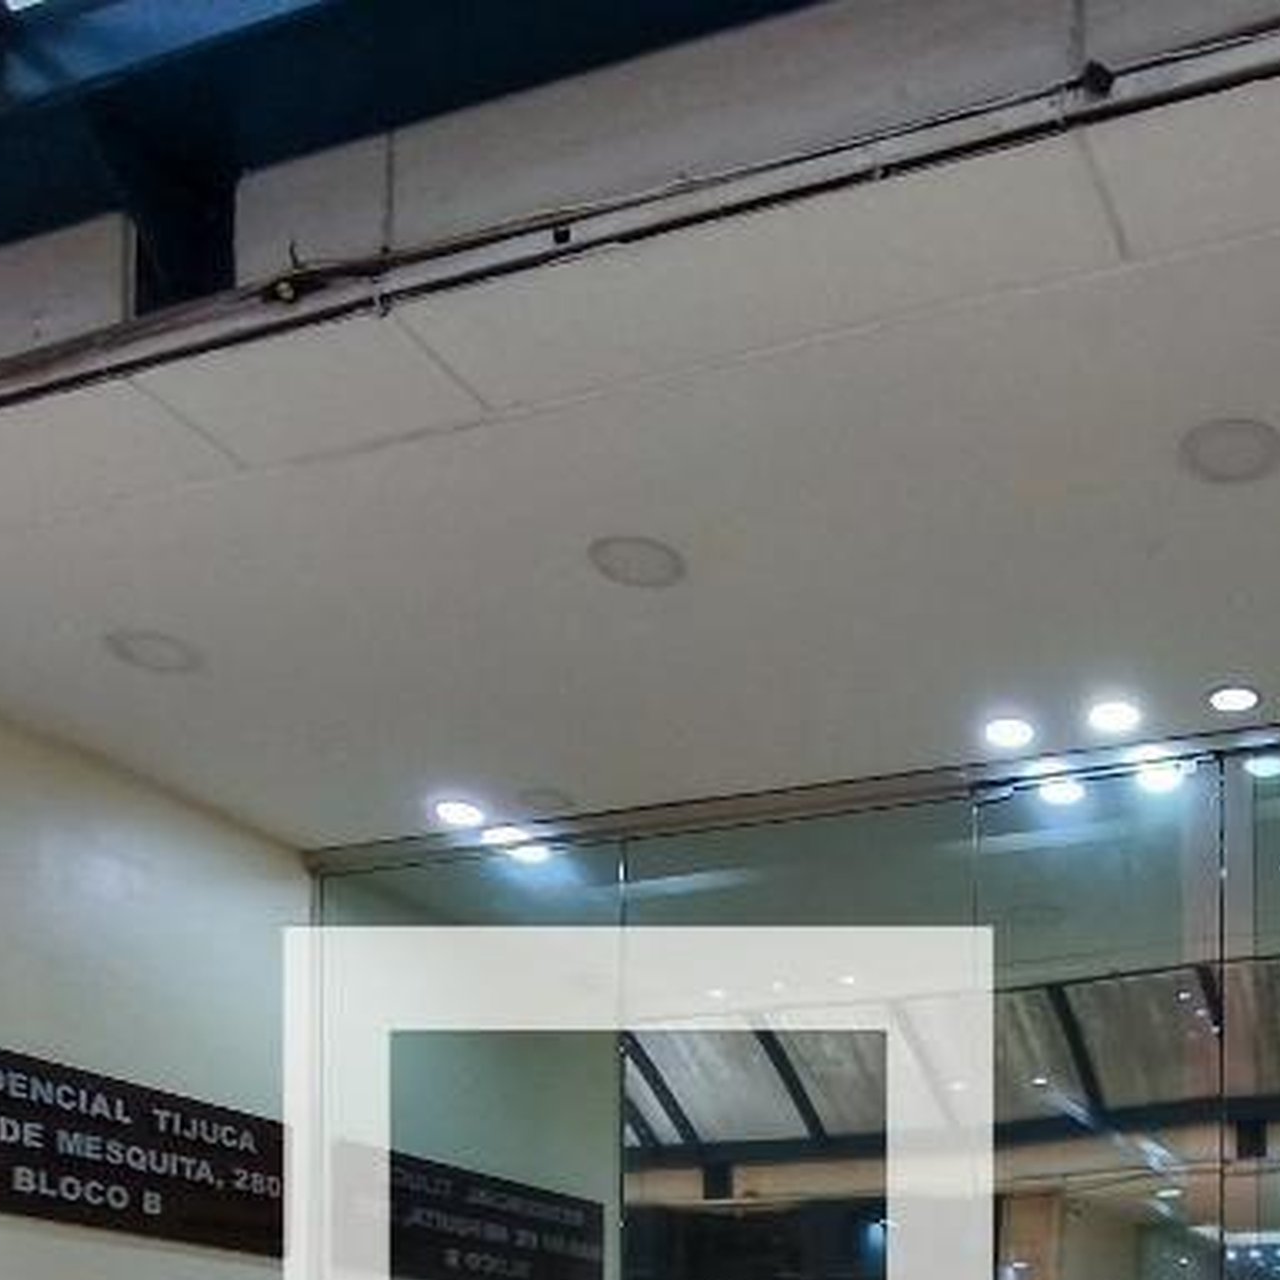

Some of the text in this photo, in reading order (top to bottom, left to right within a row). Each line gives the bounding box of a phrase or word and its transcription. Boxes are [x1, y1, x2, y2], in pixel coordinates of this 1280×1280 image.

[152, 1107, 258, 1154] TIJUCA
[56, 1128, 223, 1189] MESQUITA,
[234, 1168, 281, 1198] 280
[13, 1165, 162, 1215] BLOCO B
